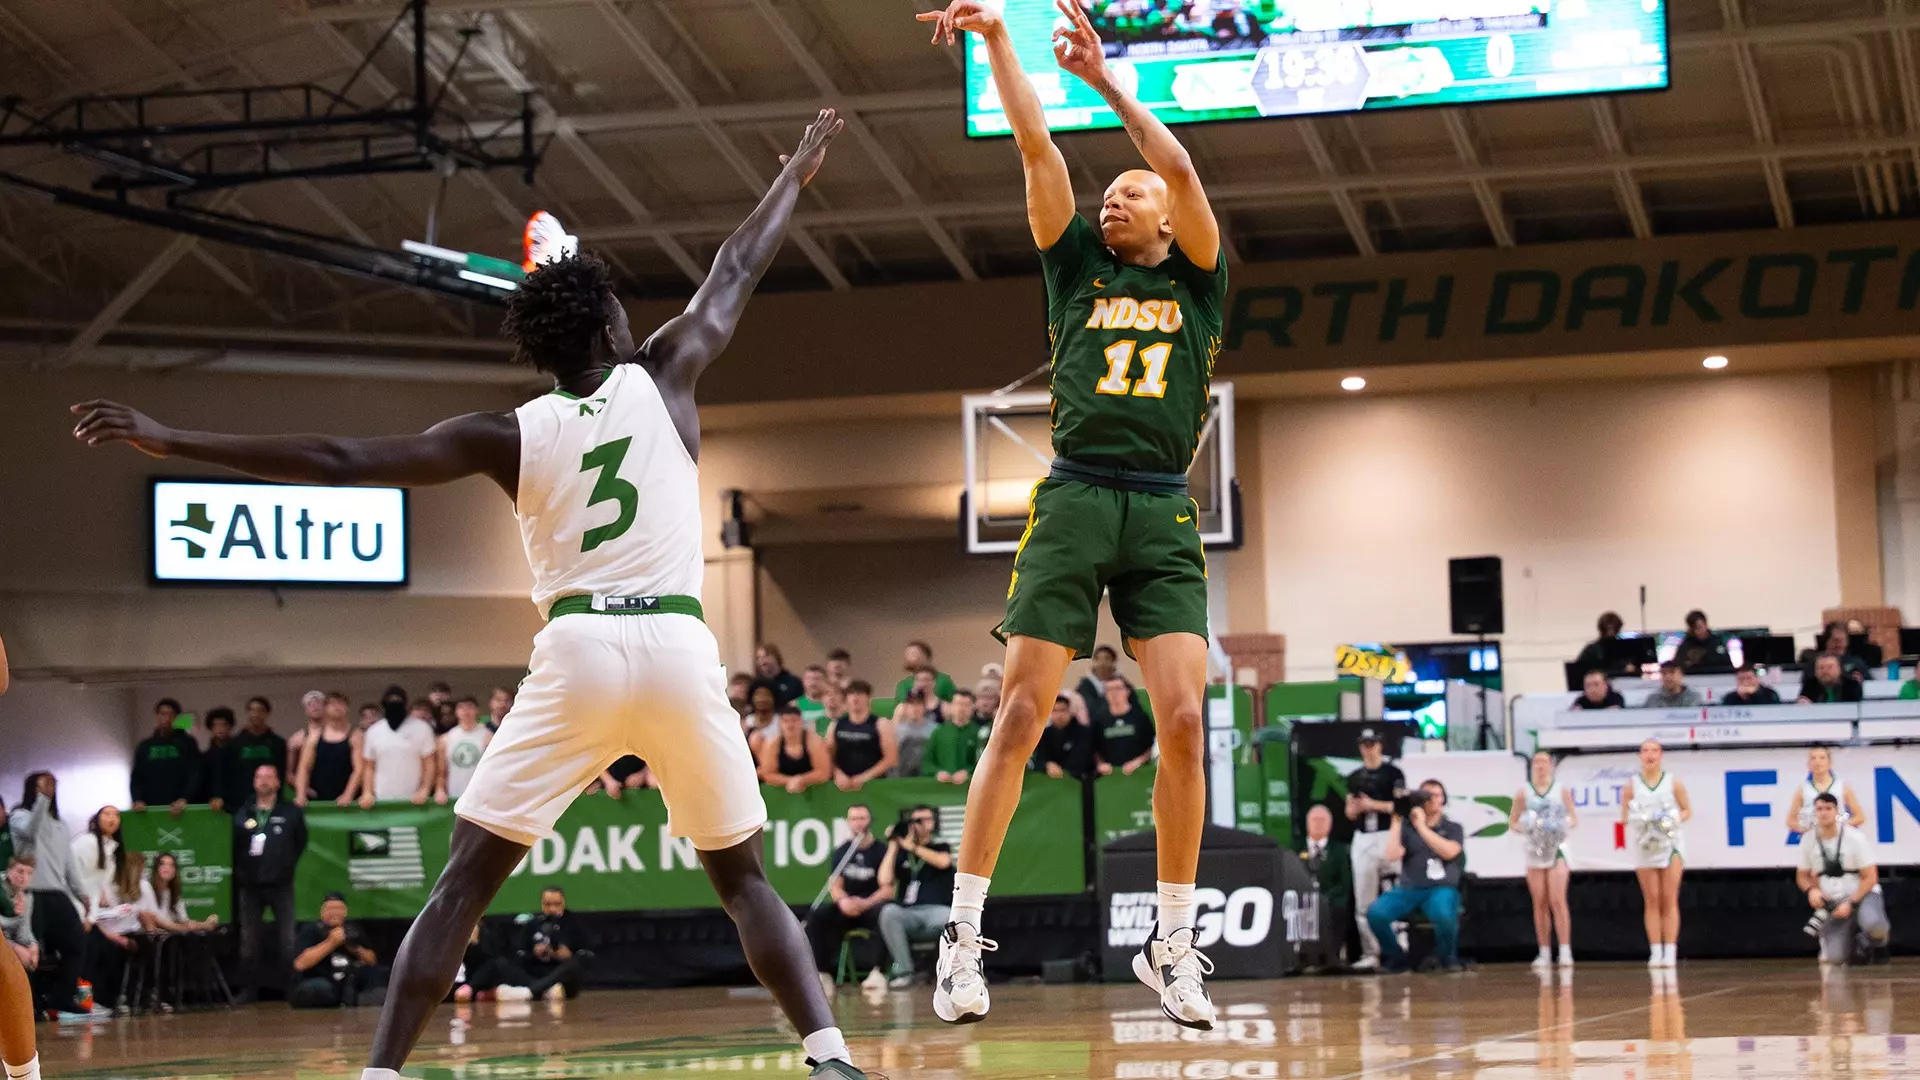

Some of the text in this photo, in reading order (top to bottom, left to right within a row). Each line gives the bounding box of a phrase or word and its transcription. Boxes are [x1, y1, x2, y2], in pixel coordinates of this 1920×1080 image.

[1085, 296, 1183, 333] NDSU
[1226, 273, 1454, 350] RTH
[1095, 339, 1174, 398] 11
[578, 435, 639, 553] 3
[219, 504, 383, 562] Altru
[1571, 784, 1623, 807] ULT
[1725, 766, 1920, 846] FN
[508, 825, 645, 876] DAK
[1110, 906, 1157, 928] WIL
[1194, 886, 1273, 947] GO
